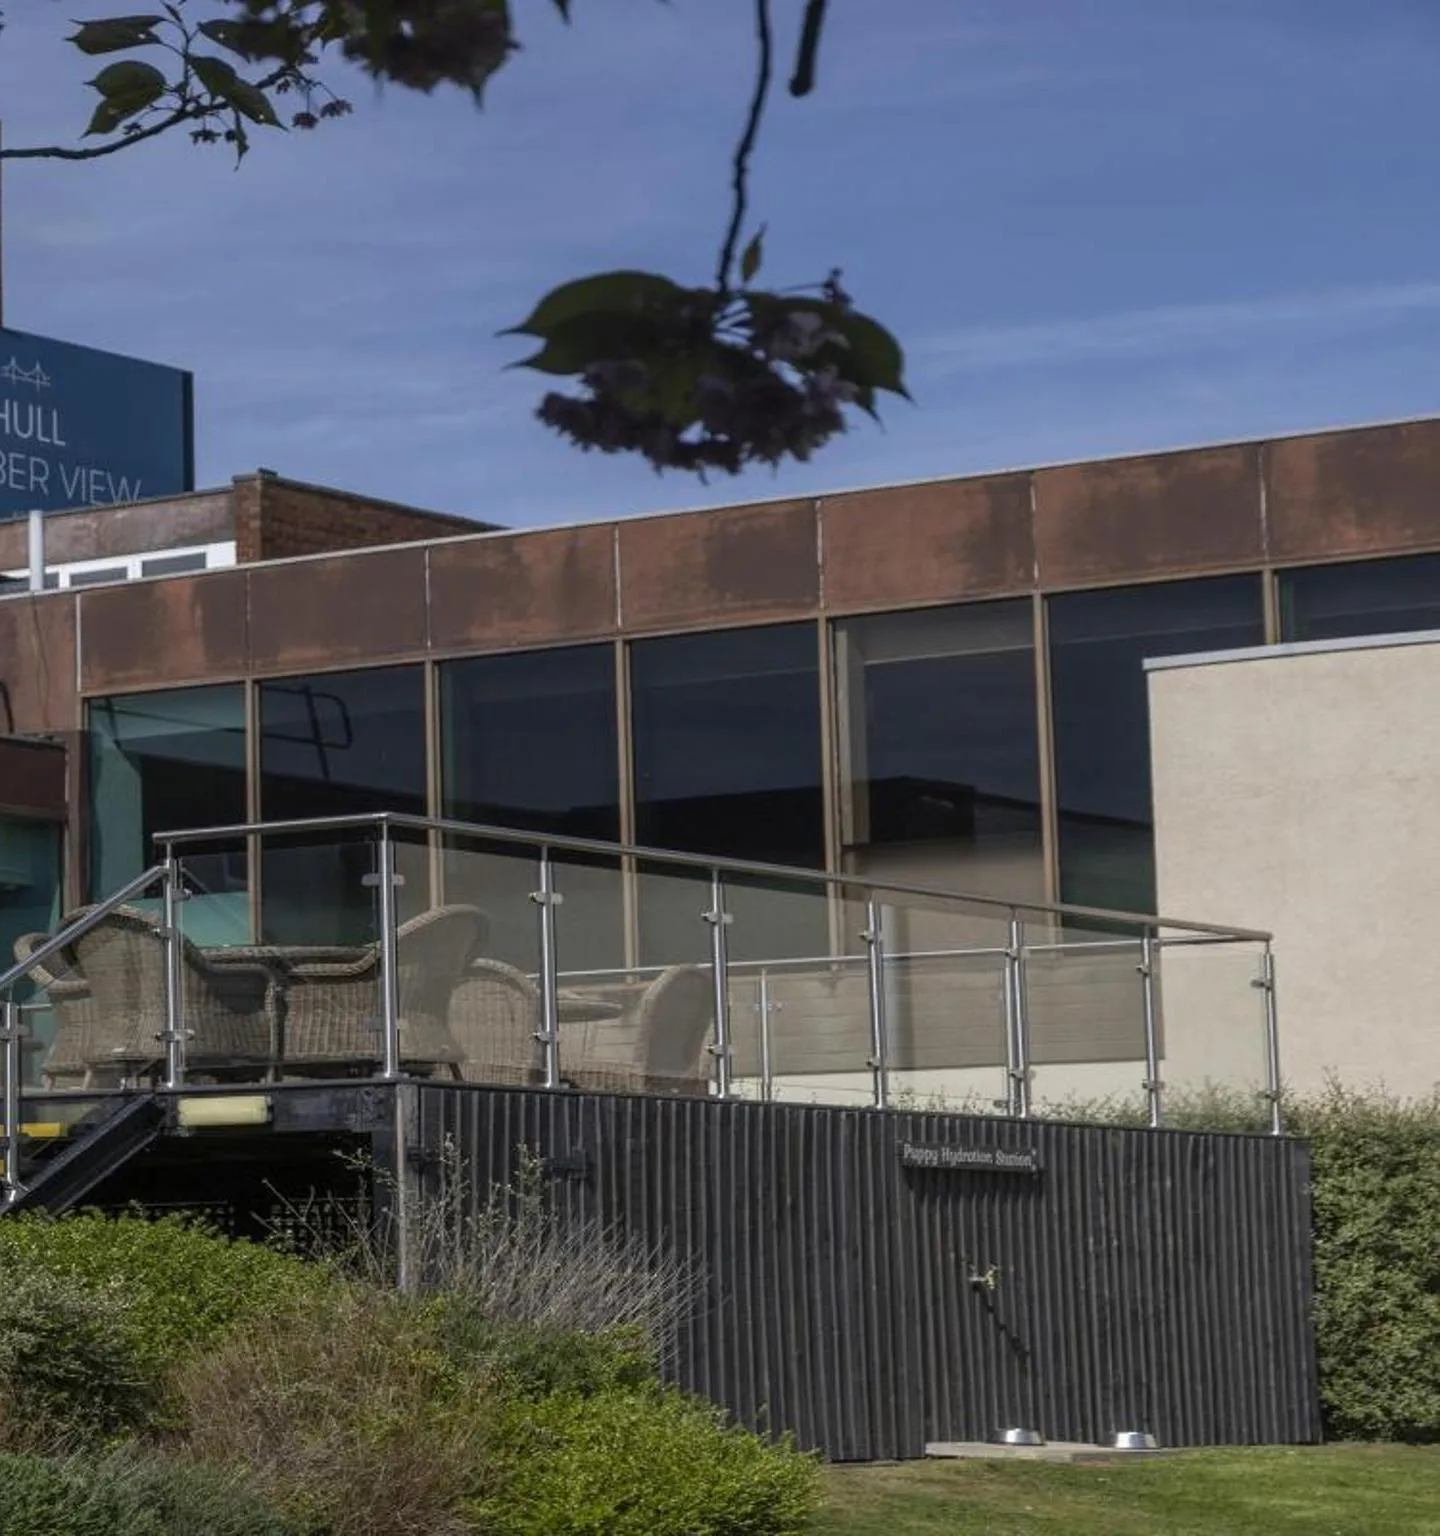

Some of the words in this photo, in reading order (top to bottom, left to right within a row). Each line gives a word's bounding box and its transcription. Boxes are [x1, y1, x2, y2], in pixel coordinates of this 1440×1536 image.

[59, 461, 142, 506] VIEW
[903, 1143, 938, 1165] Puppy
[941, 1147, 993, 1167] Hydration
